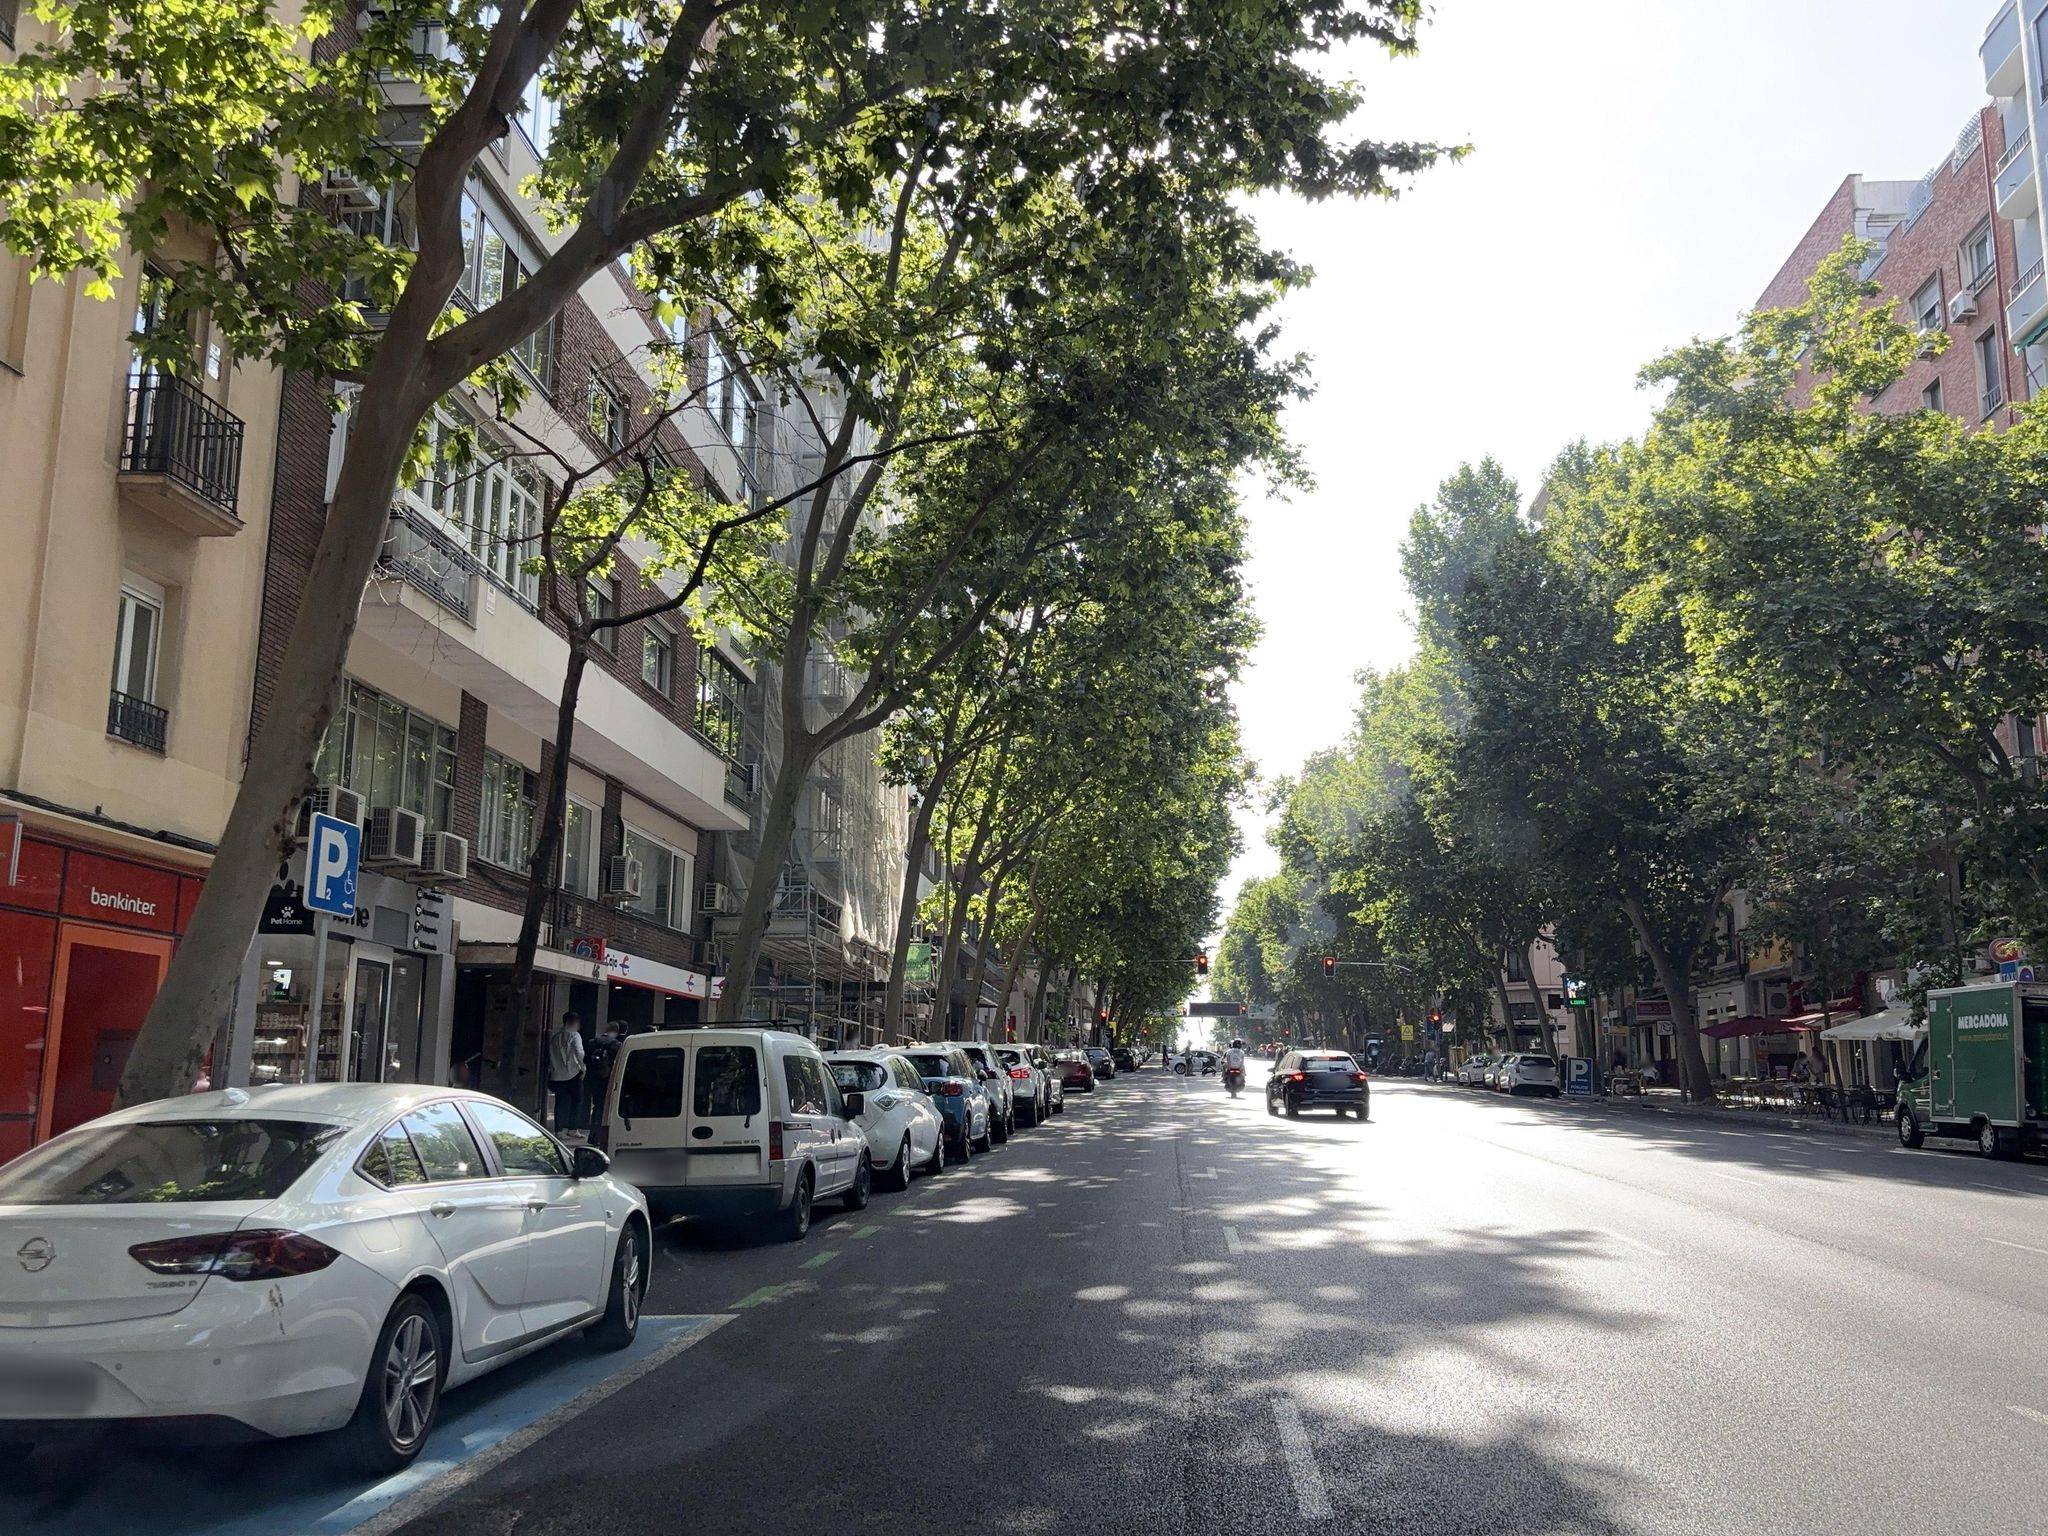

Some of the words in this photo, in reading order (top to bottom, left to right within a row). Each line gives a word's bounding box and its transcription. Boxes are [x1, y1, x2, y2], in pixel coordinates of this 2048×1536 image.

[316, 827, 348, 899] P
[326, 888, 331, 900] 2
[1958, 1013, 2009, 1029] MERCADONA
[1571, 1060, 1588, 1081] P
